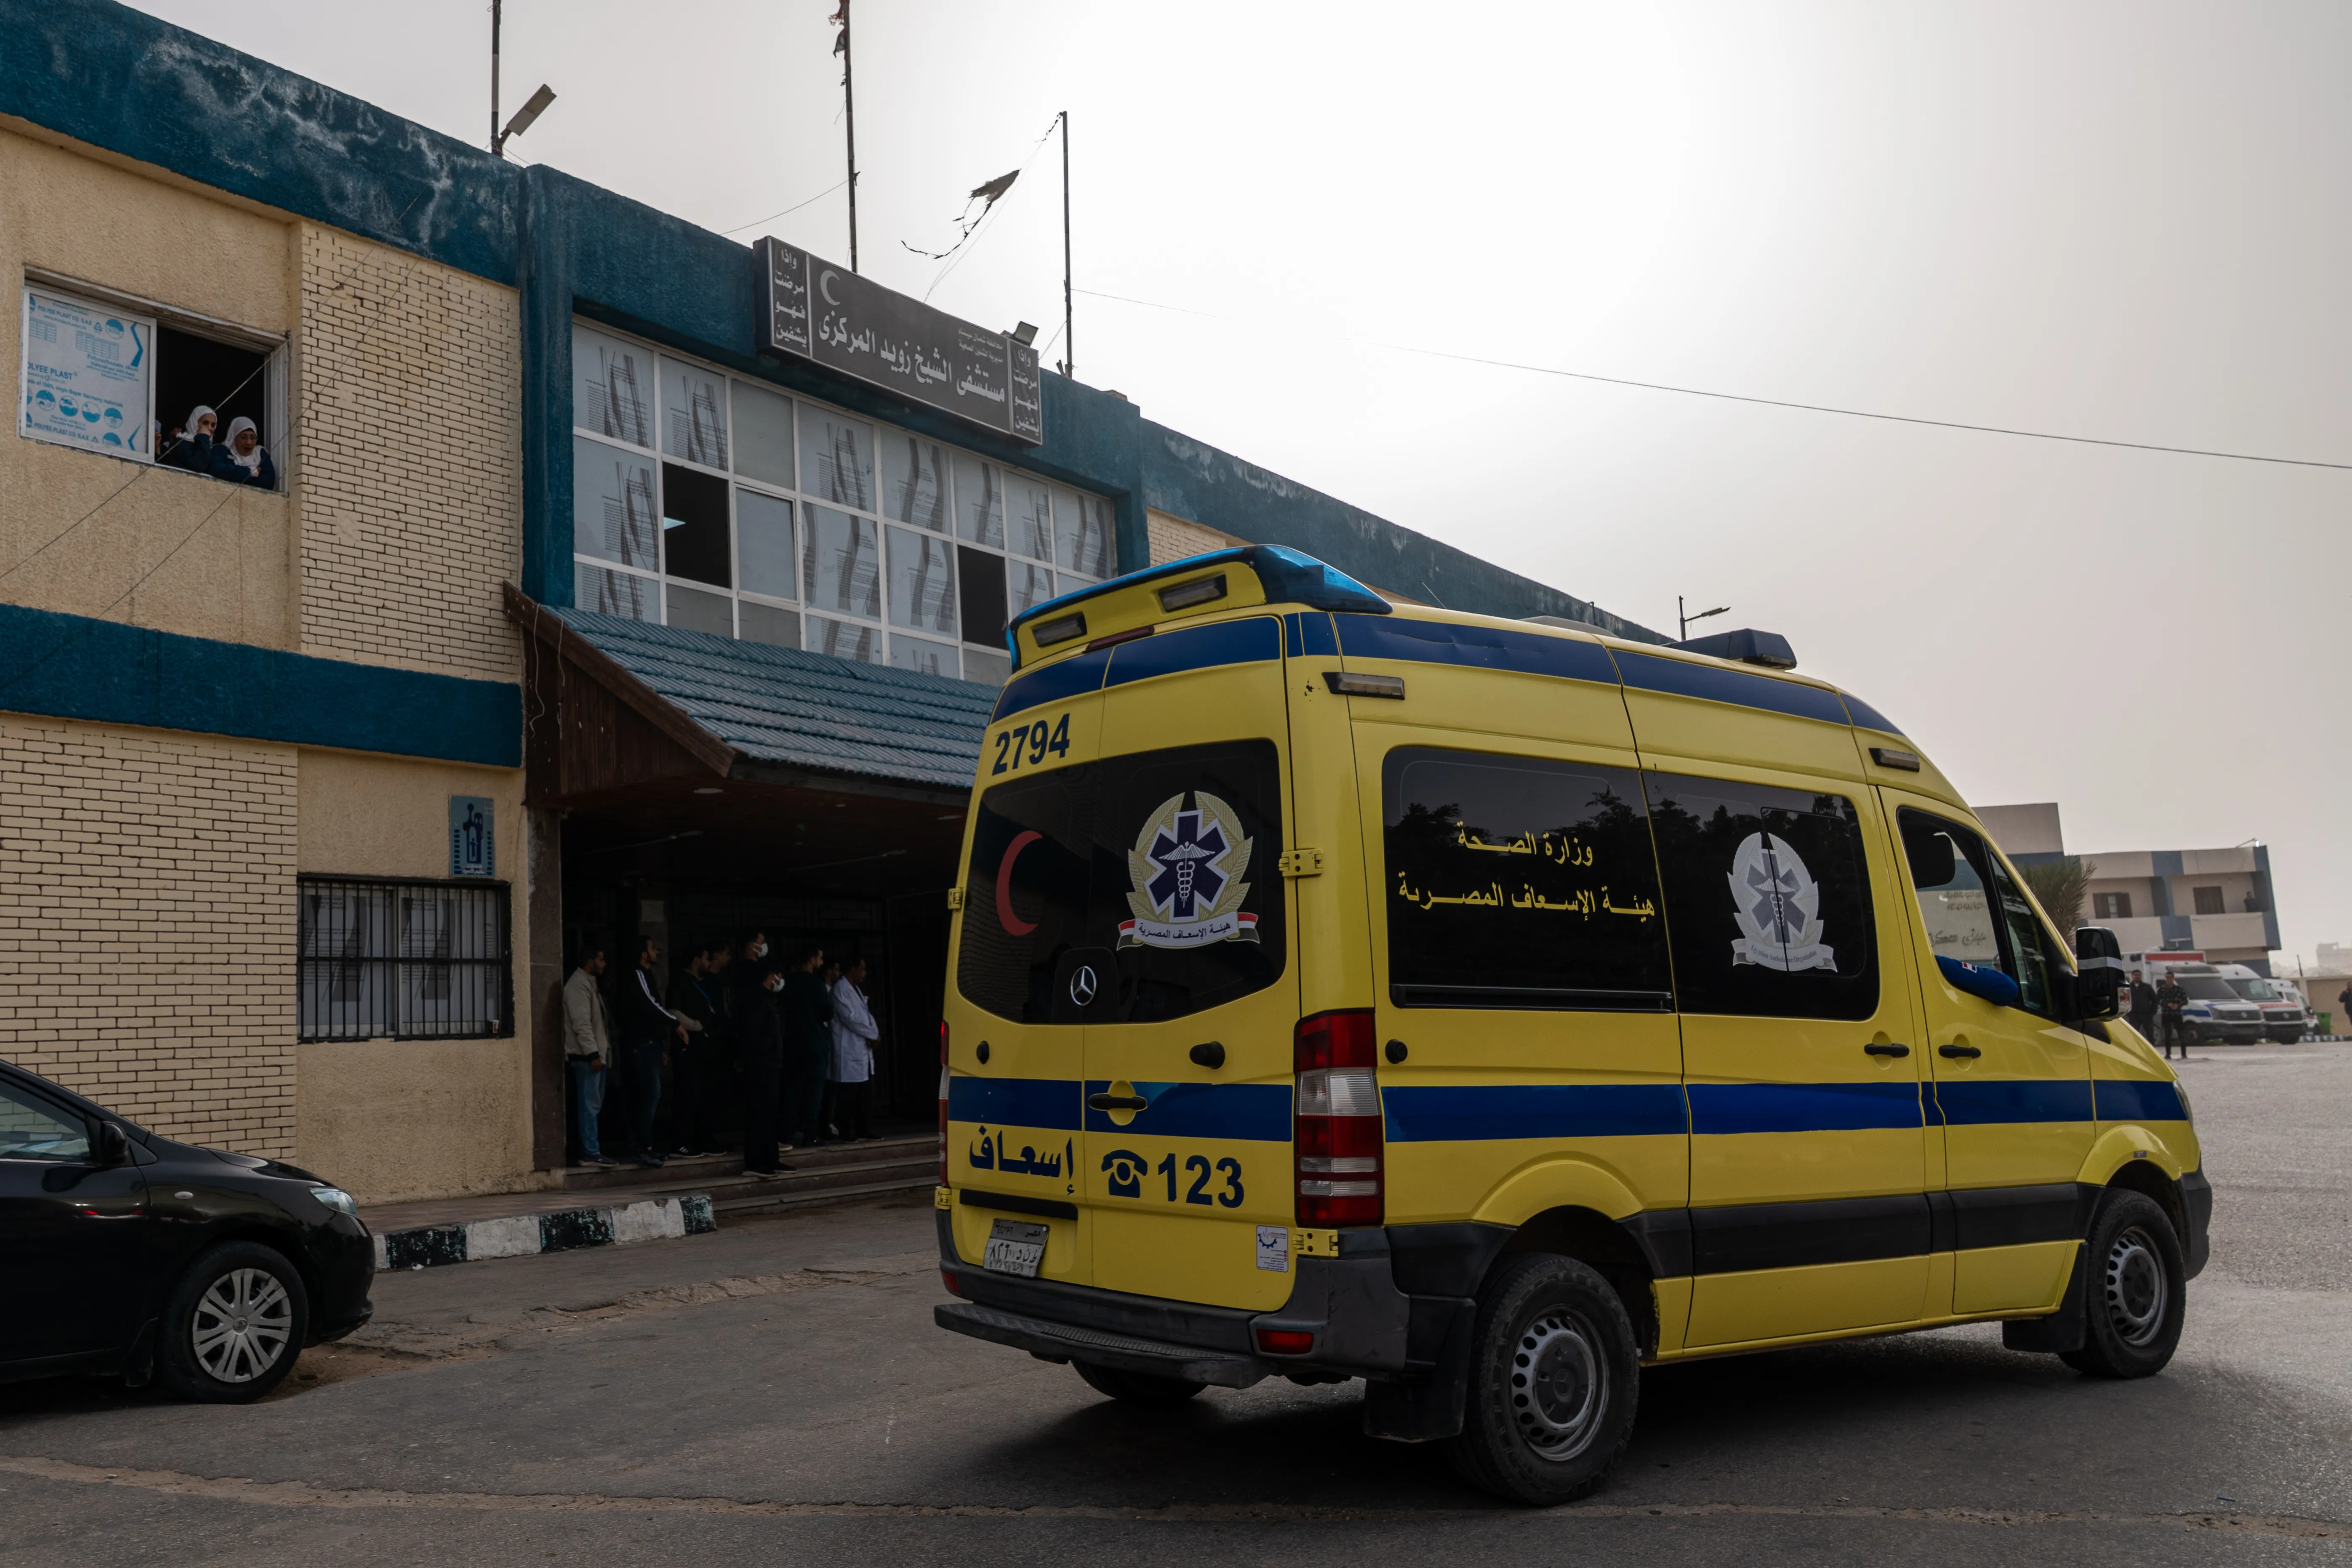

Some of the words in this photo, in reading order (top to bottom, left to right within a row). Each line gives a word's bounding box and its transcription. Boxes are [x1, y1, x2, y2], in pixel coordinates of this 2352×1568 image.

[880, 341, 911, 374] زويد
[915, 345, 952, 385] الشيخ
[956, 363, 1005, 402] مستشفى
[992, 713, 1070, 776] 2794
[1457, 821, 1536, 855] الصحة
[1543, 832, 1593, 866] وزارة
[1512, 883, 1595, 921] الإسعاف
[1601, 886, 1654, 922] هيئة
[1138, 923, 1170, 938] المصرية
[1173, 927, 1207, 940] الإسعاف
[1209, 922, 1231, 934] هيئة
[970, 1125, 1075, 1195] إسعاف
[1158, 1153, 1244, 1209] 123
